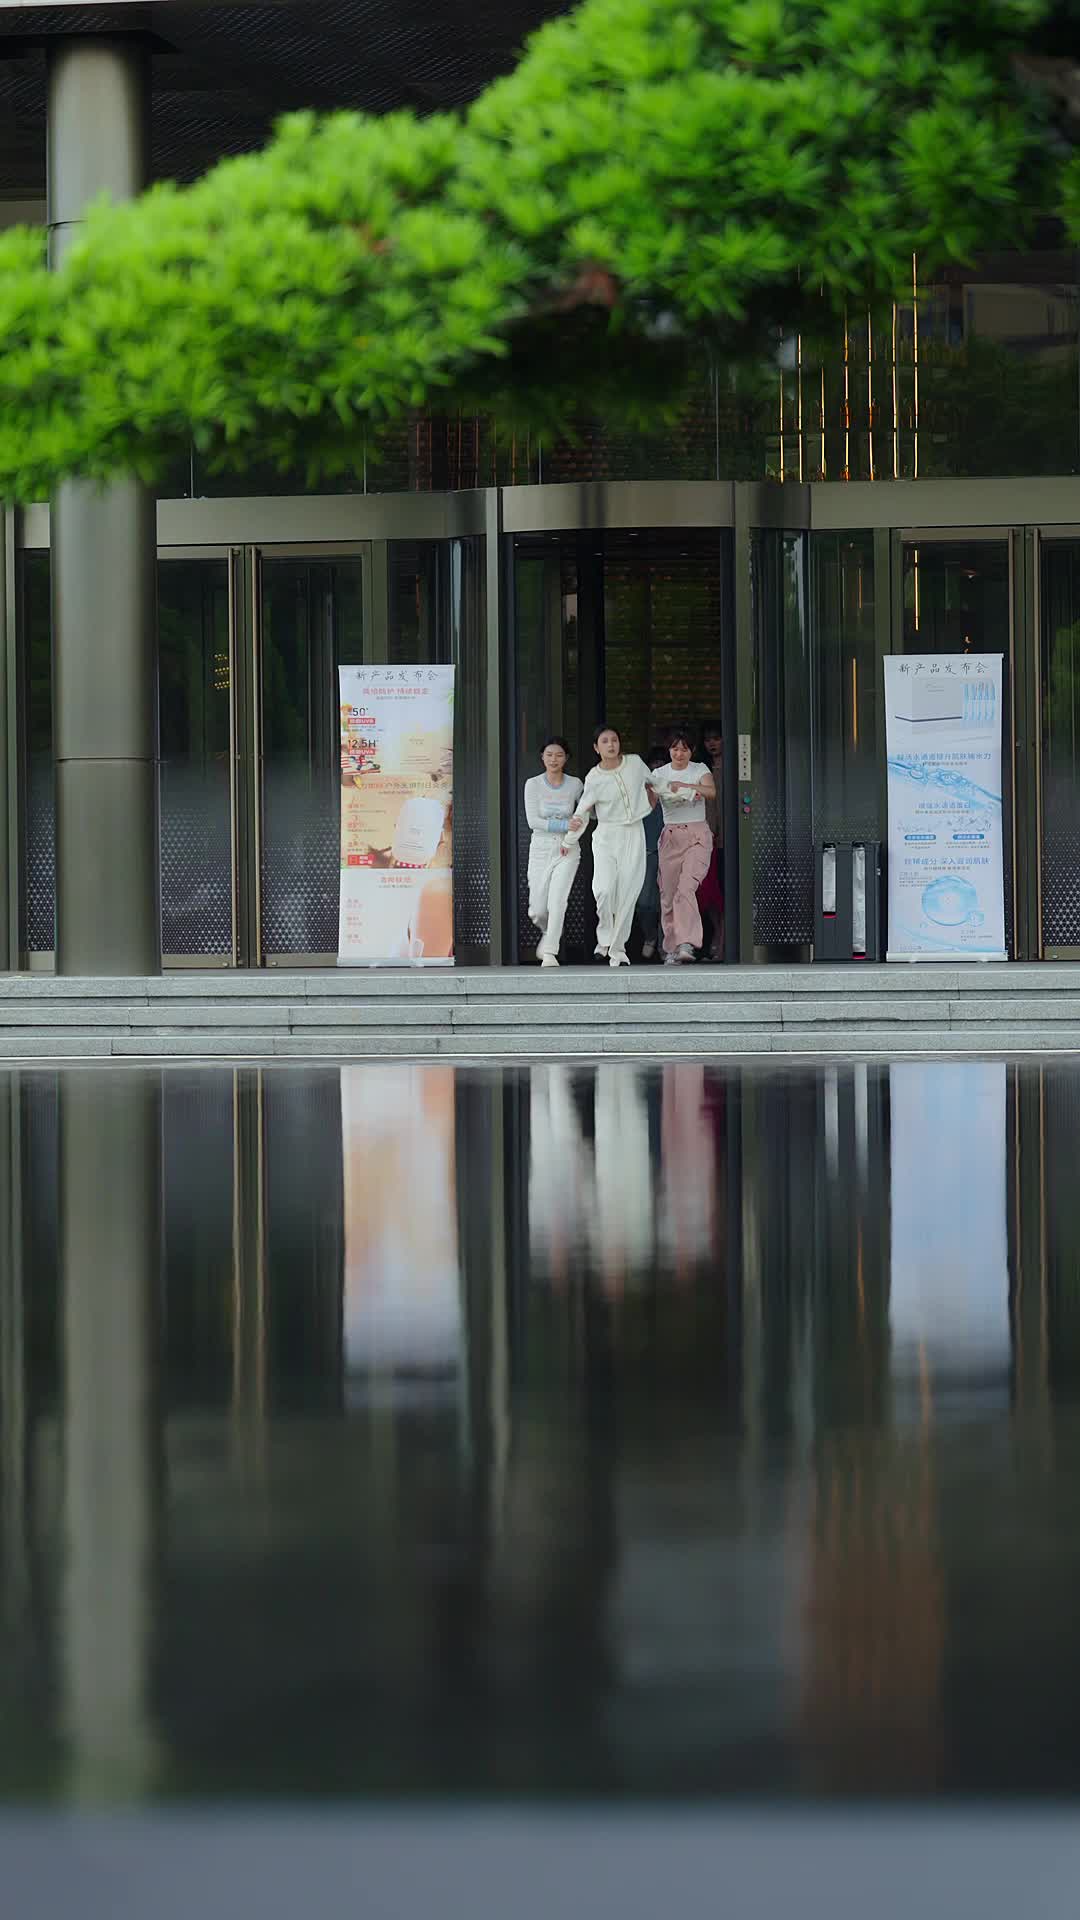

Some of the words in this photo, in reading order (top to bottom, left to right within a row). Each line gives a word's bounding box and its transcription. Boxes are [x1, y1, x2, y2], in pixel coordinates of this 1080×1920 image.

[898, 662, 989, 676] 新产品发布会
[356, 670, 440, 682] 新产品发布会
